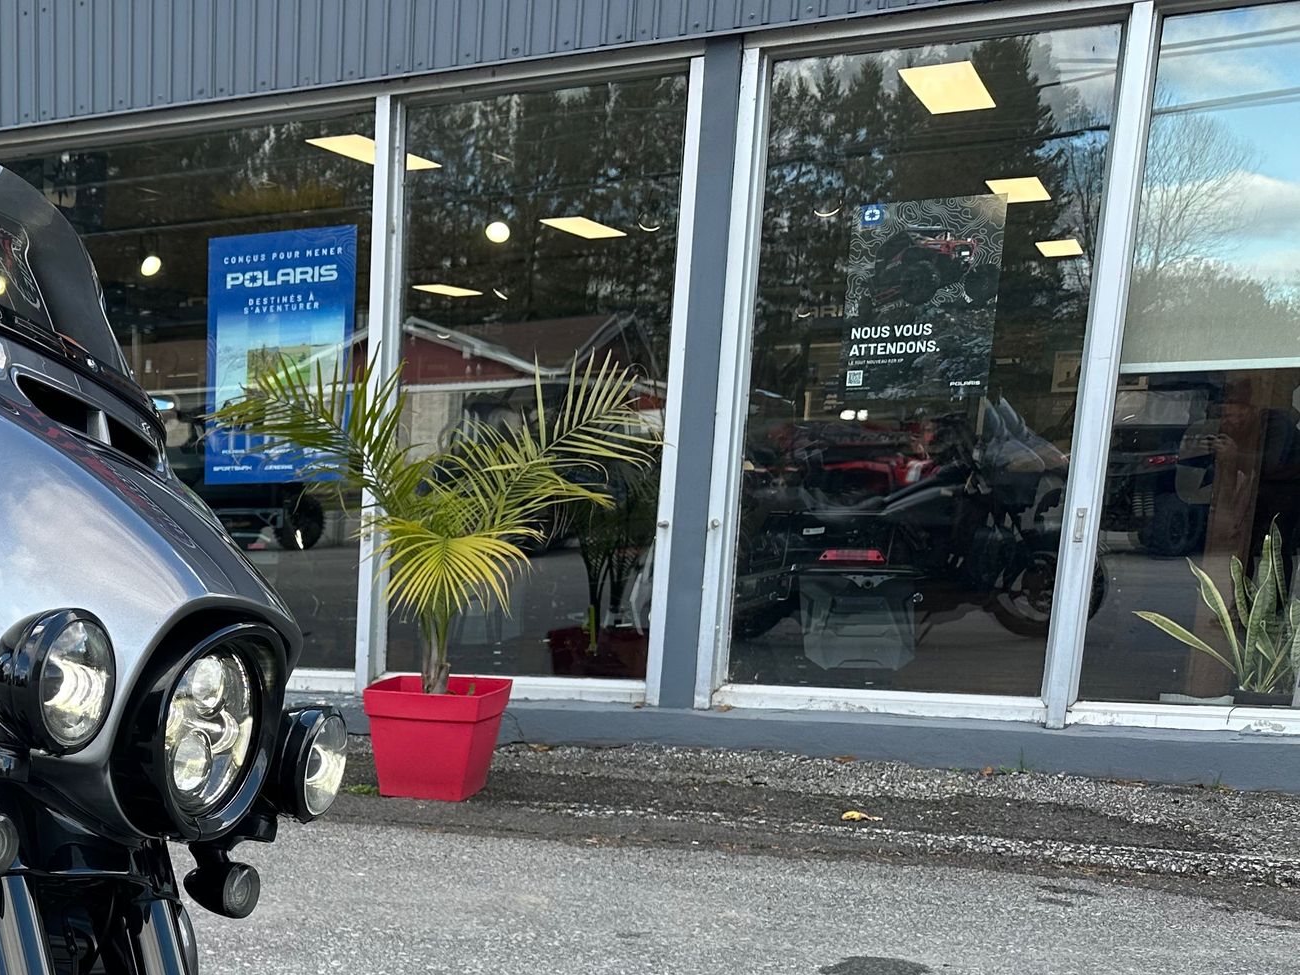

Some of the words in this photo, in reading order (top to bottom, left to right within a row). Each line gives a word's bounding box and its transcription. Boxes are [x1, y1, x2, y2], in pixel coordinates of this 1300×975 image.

[223, 253, 266, 265] CONÇUS
[271, 250, 300, 261] POUR
[305, 246, 343, 258] MENER
[226, 264, 339, 289] POLARIS
[248, 294, 302, 307] DESTINÉS
[308, 290, 315, 302] À
[243, 301, 320, 315] S'AVENTURER
[851, 326, 891, 340] NOUS
[894, 323, 933, 337] VOUS
[849, 340, 940, 357] ATTENDONS.
